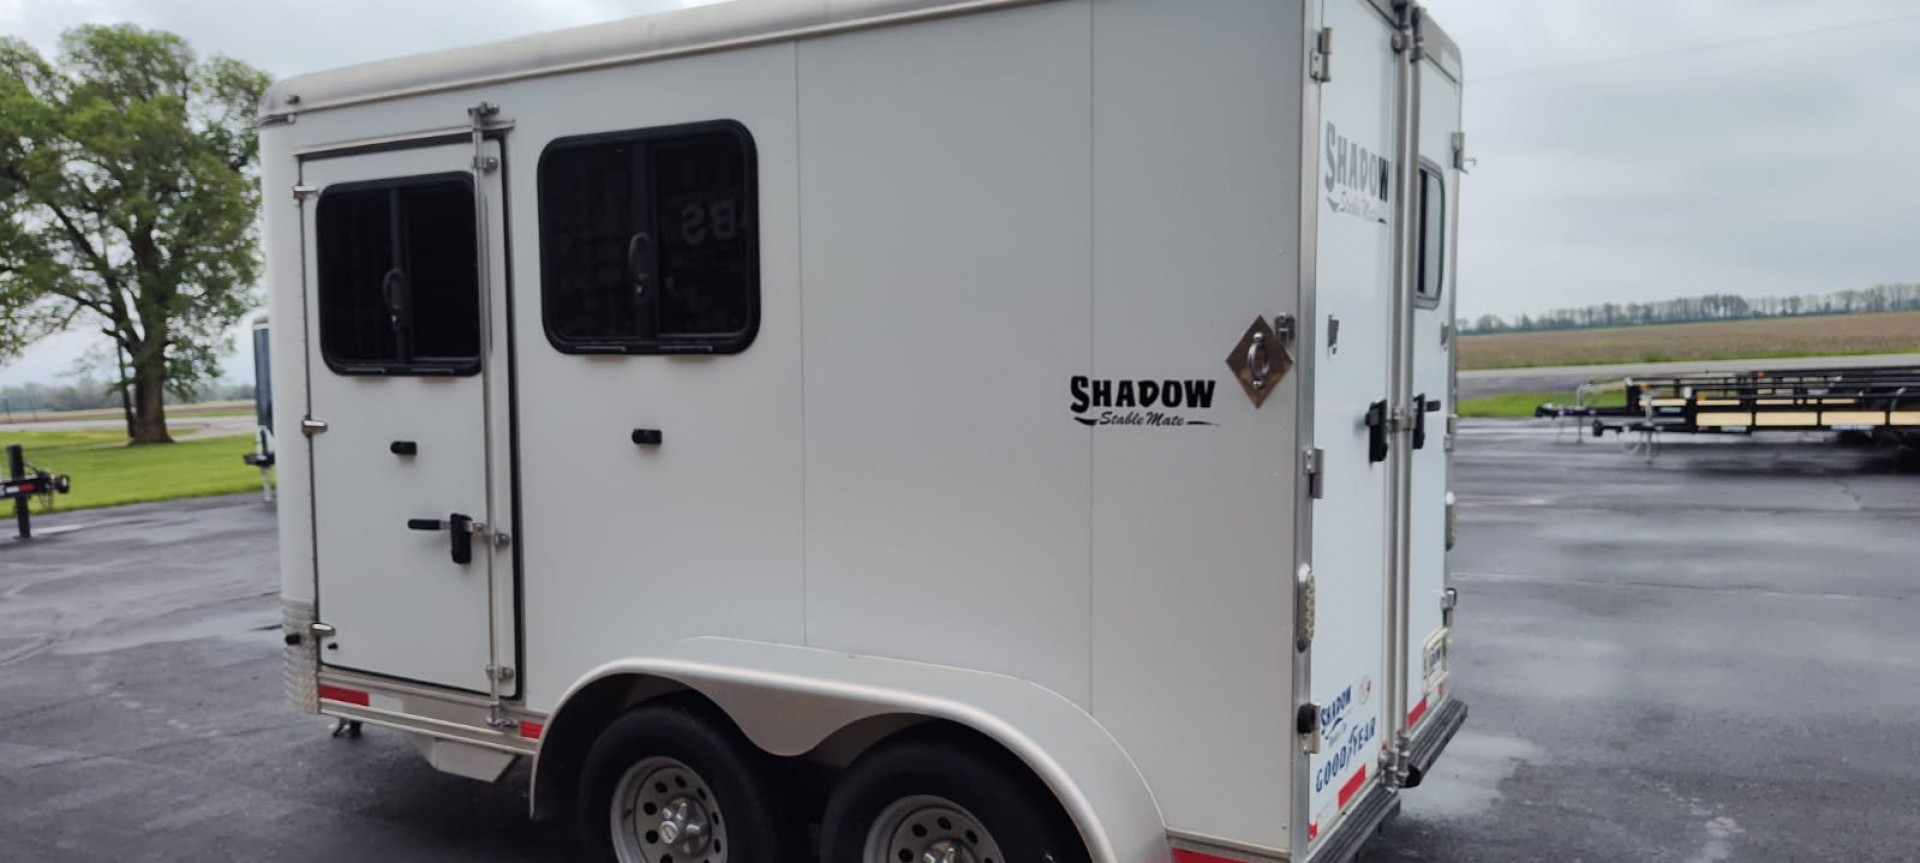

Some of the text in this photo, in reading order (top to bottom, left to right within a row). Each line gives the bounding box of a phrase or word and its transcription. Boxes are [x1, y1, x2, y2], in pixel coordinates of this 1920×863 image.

[1325, 121, 1389, 203] SHADOW
[1070, 375, 1216, 414] SHADOW
[1099, 410, 1185, 426] Stable Mate
[1321, 684, 1352, 727] SHADOW
